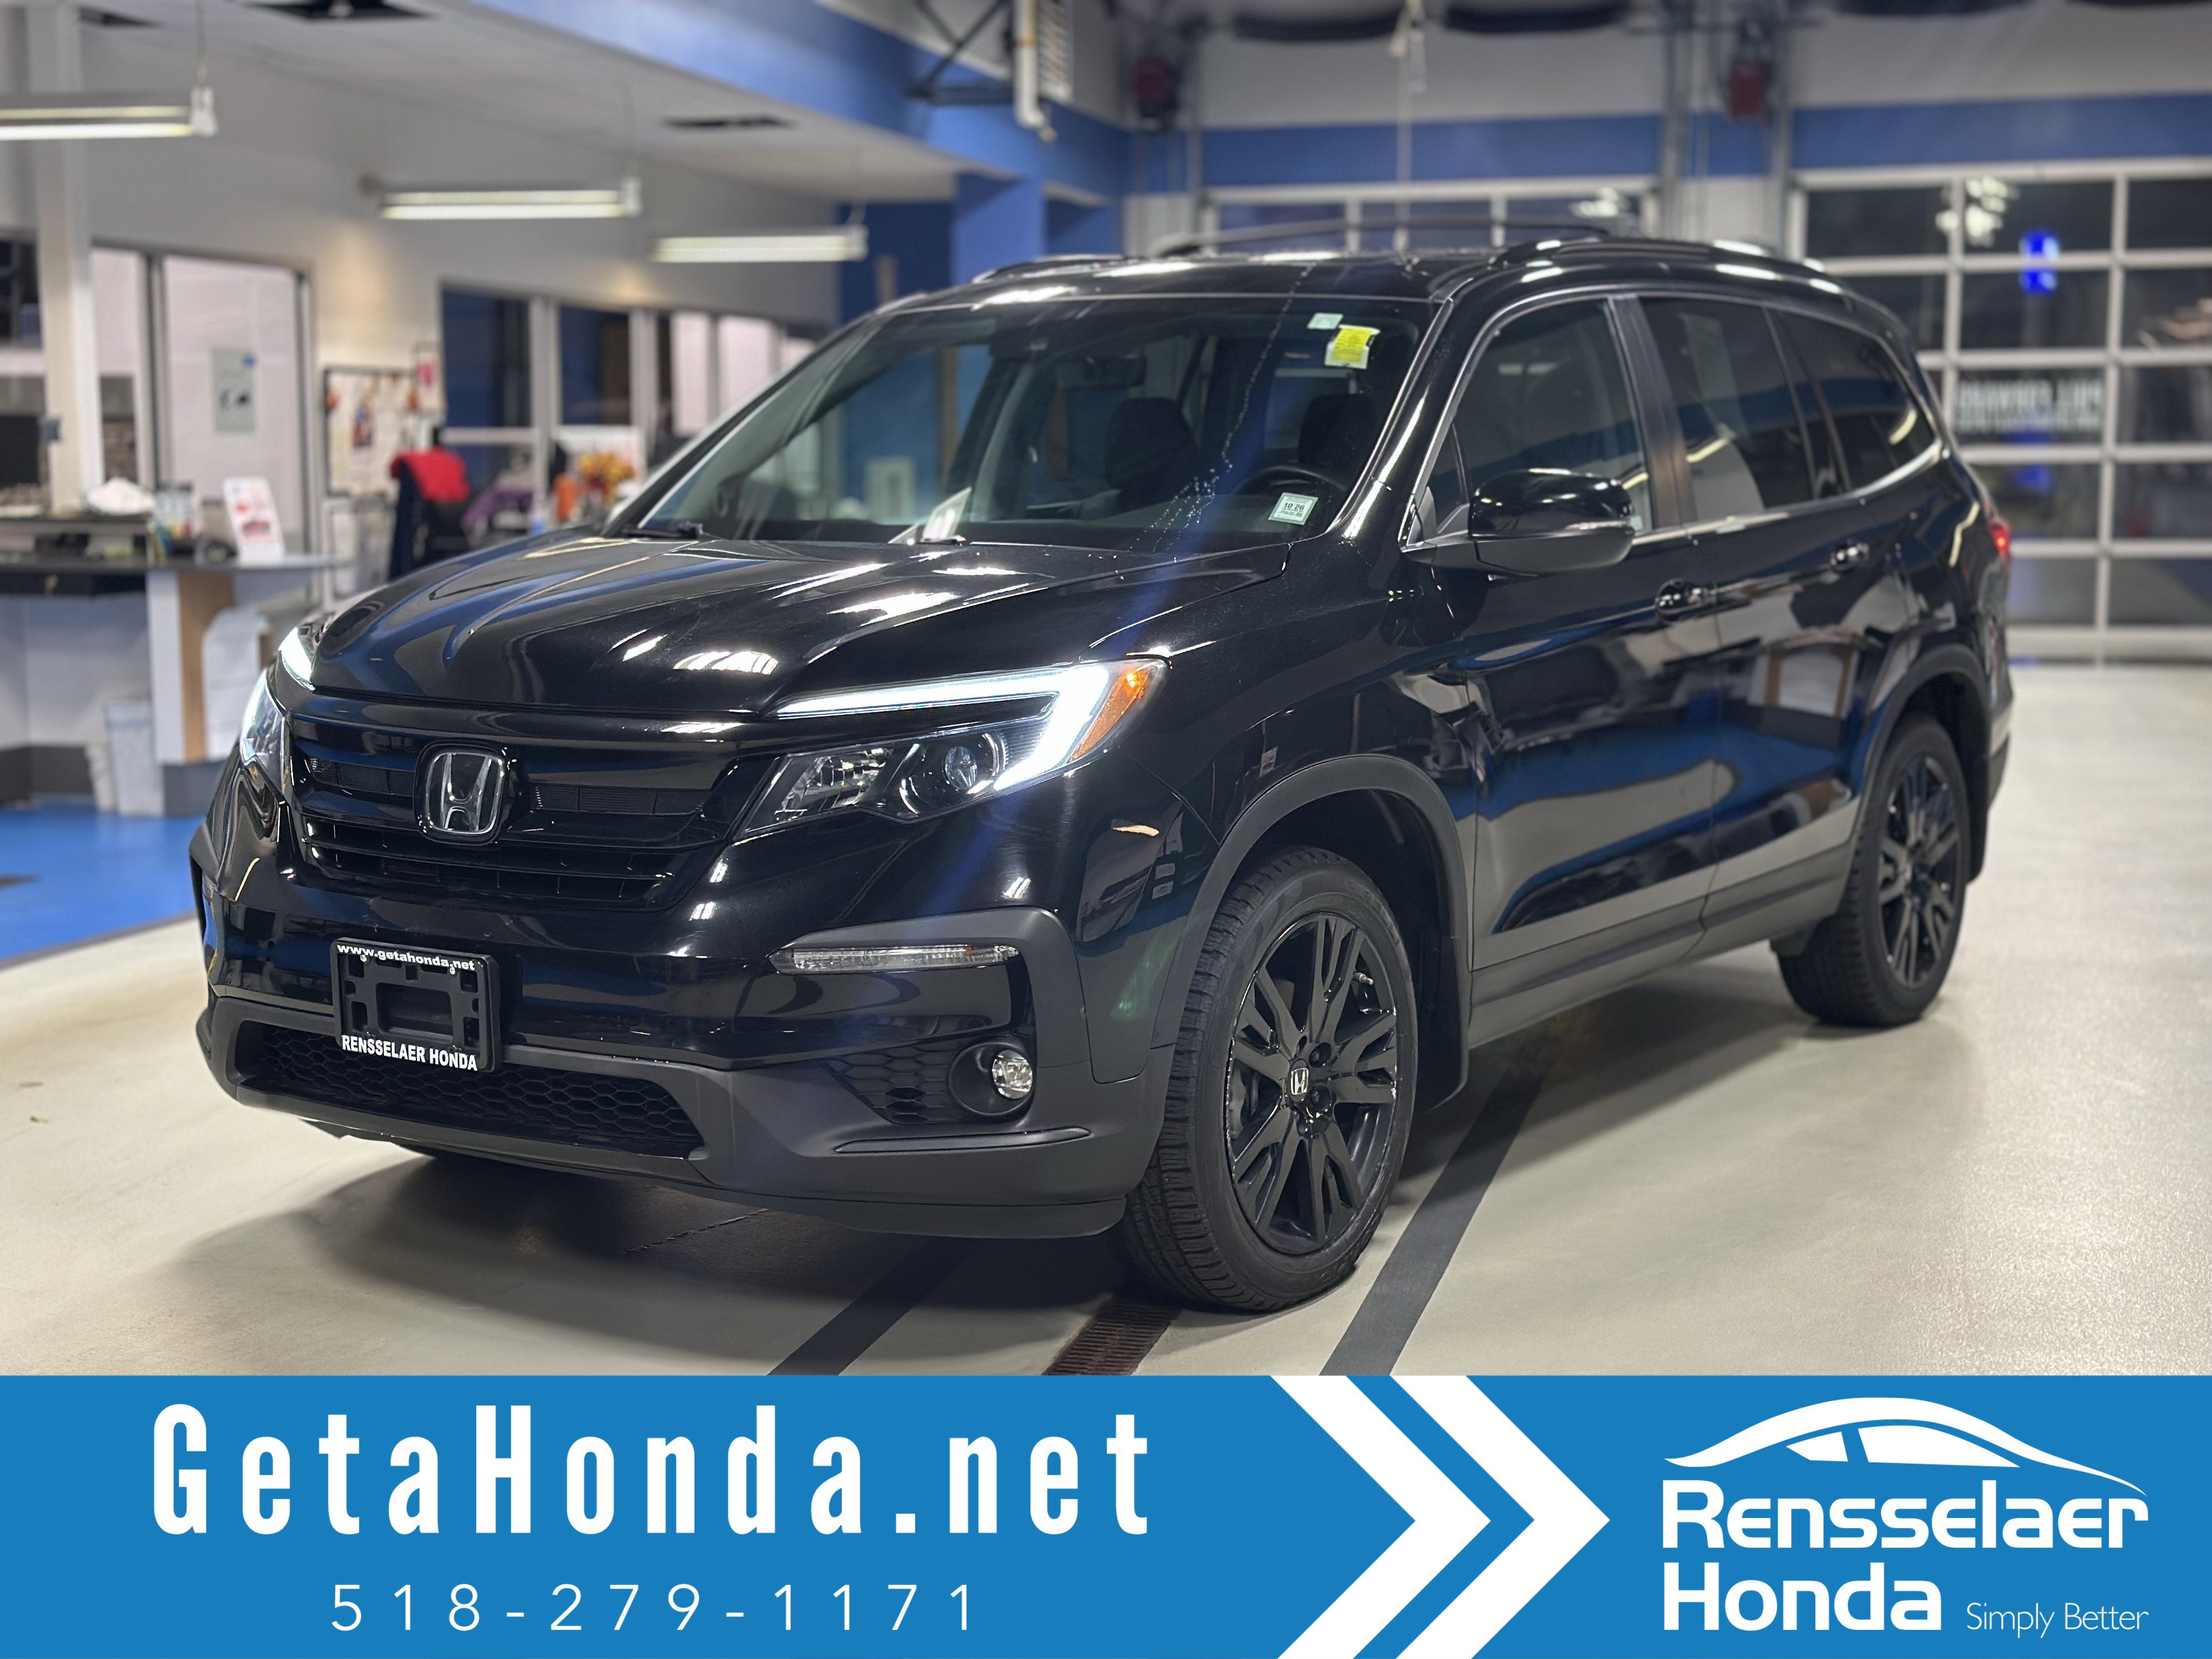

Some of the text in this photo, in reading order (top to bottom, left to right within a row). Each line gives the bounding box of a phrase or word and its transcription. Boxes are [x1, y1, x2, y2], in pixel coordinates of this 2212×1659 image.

[337, 944, 475, 970] www.getahonda.net
[341, 1035, 478, 1071] RENSSELAER HONDA
